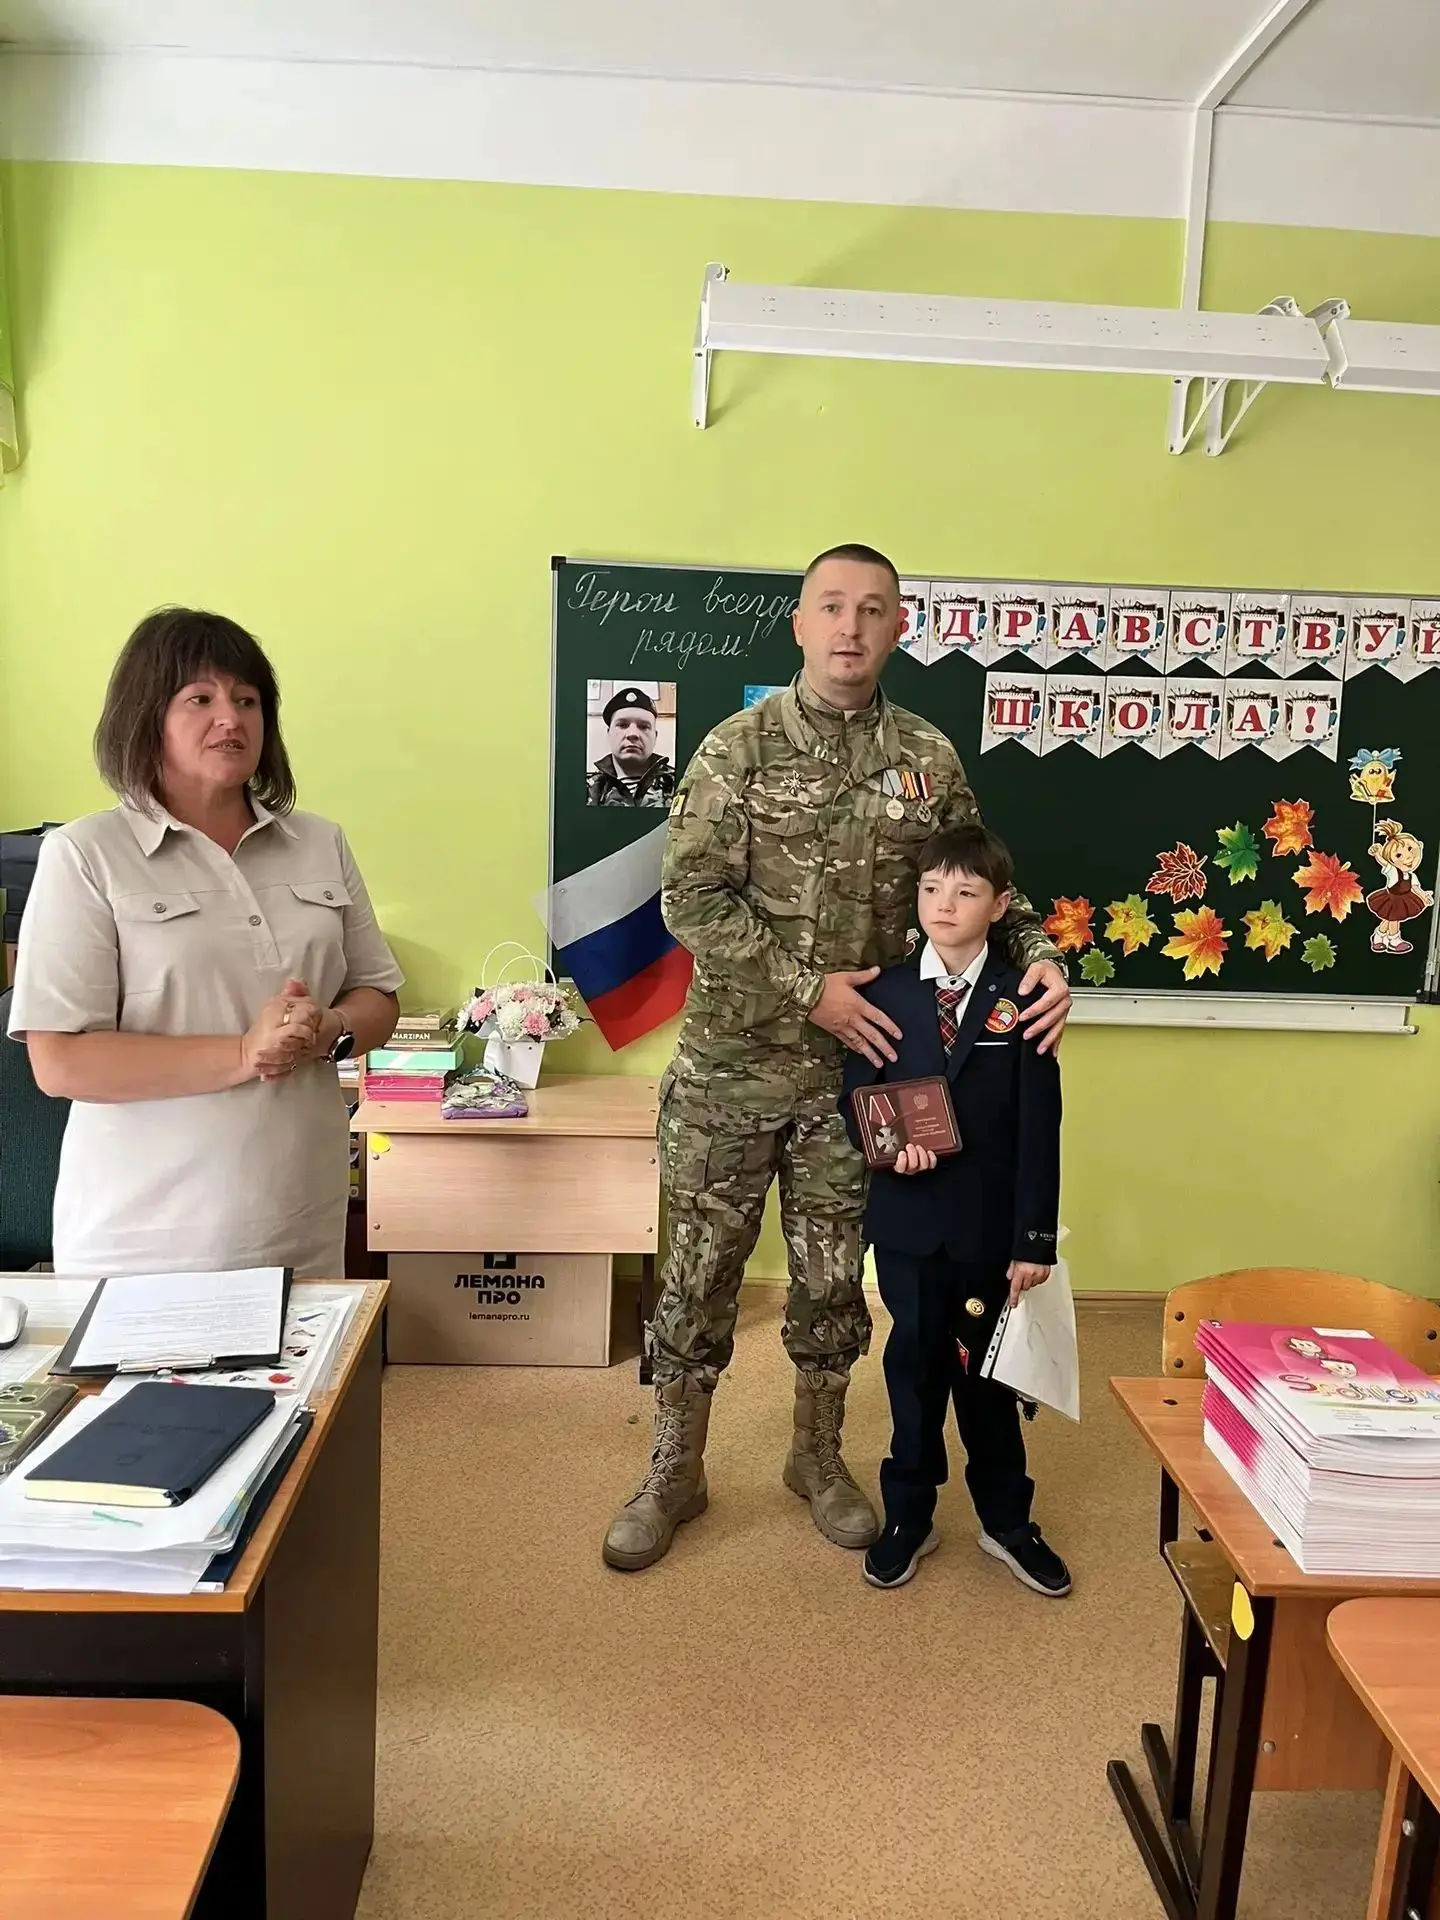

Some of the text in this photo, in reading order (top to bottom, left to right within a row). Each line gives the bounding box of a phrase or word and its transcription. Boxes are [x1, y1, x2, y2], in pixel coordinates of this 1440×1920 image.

[567, 571, 680, 626] Герои
[629, 619, 760, 670] рядом!
[993, 698, 1317, 735] ШКОЛА!
[453, 1274, 546, 1289] ЛЕМАНА
[477, 1290, 521, 1305] ПРО
[469, 1312, 530, 1322] lemanapro.ru
